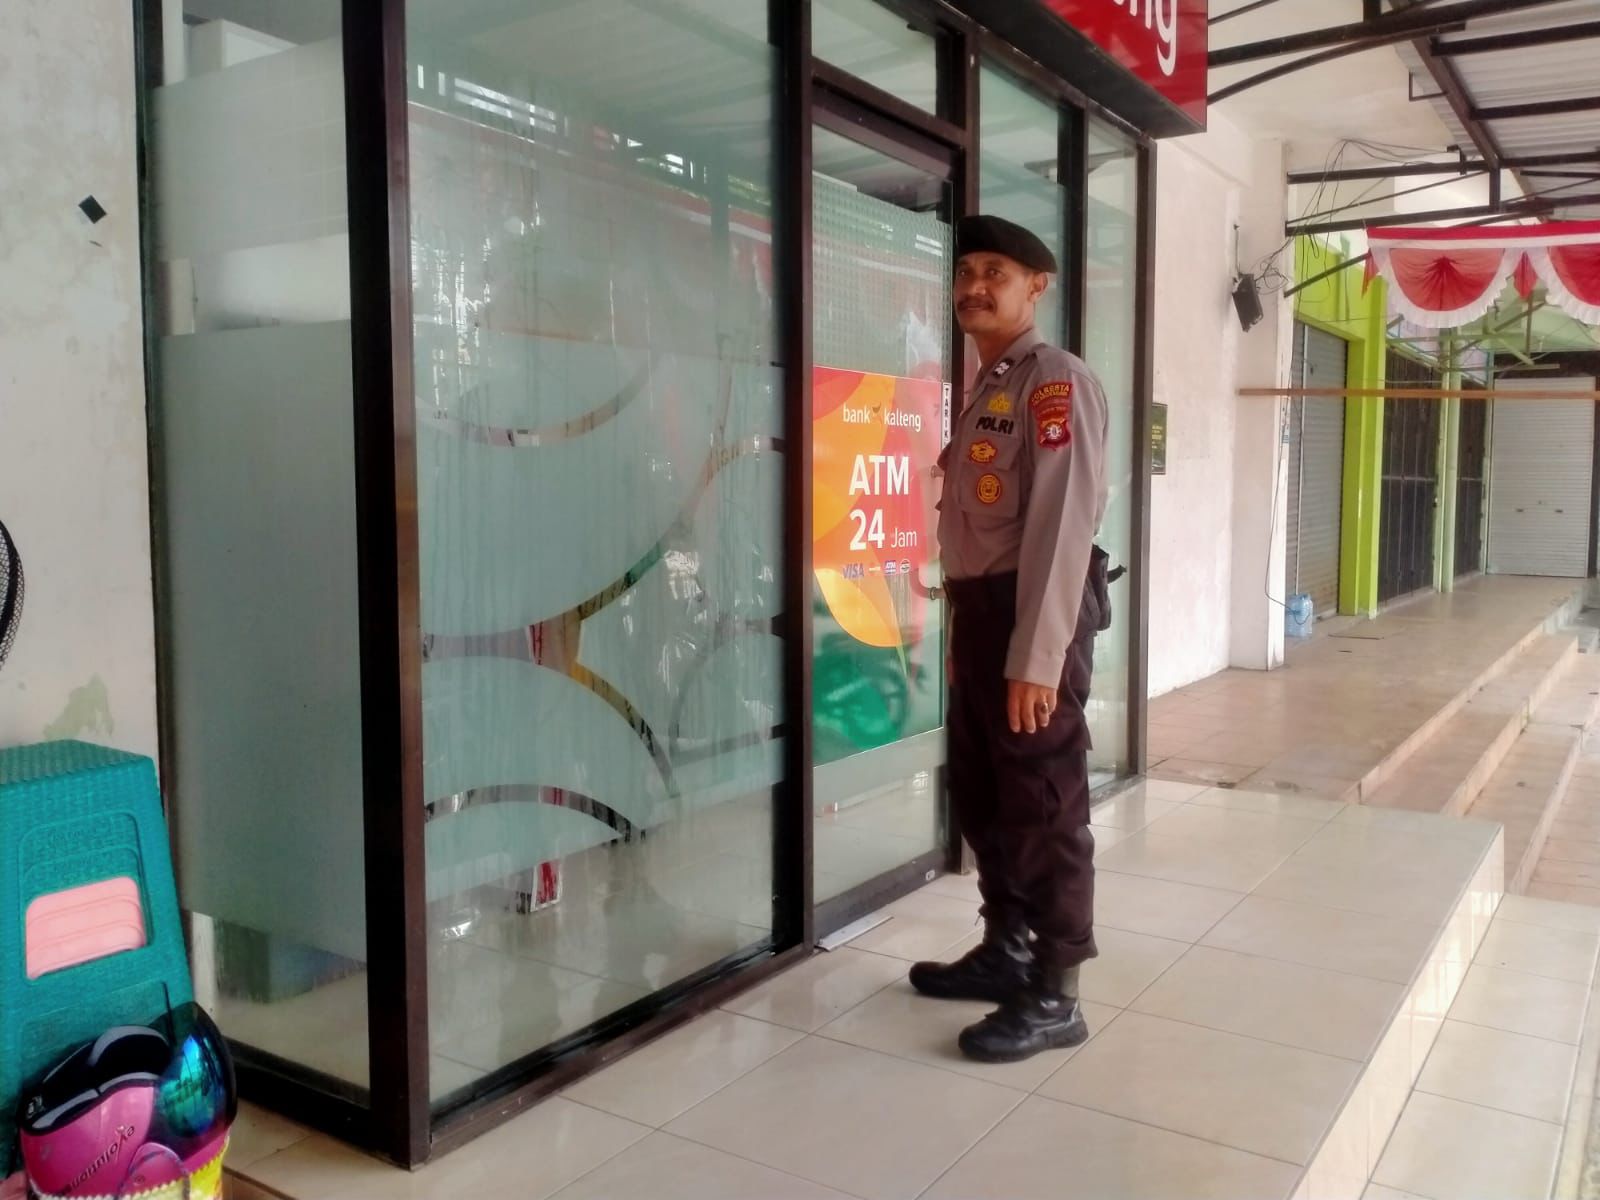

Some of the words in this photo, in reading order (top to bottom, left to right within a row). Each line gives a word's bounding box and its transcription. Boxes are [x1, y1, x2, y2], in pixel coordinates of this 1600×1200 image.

[843, 402, 870, 424] bank
[884, 408, 921, 433] kalteng
[975, 416, 1014, 435] POLRI
[849, 454, 909, 496] ATM
[850, 508, 885, 551] 24
[890, 527, 917, 549] Jam
[843, 562, 864, 579] VISA
